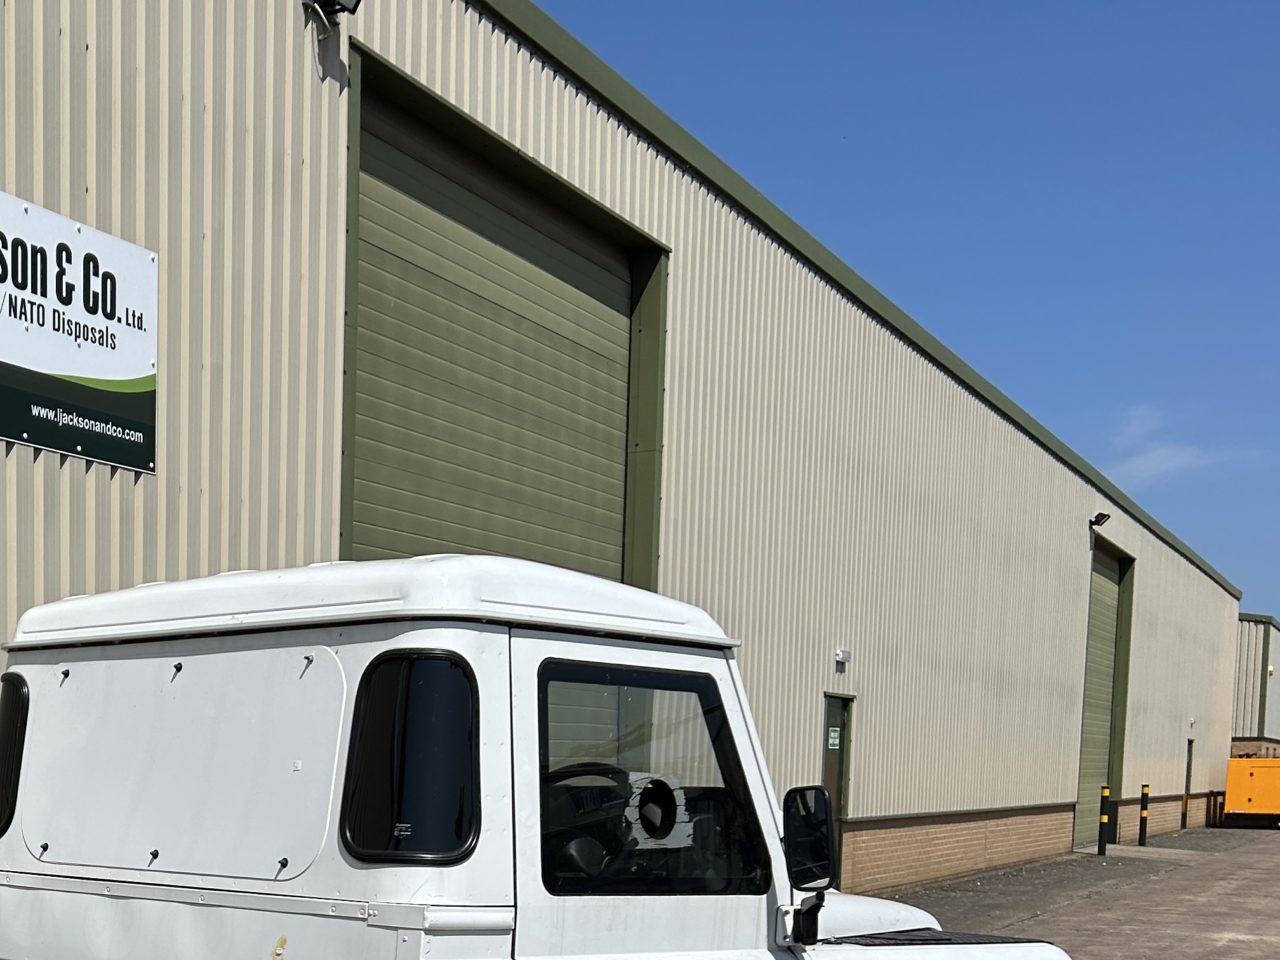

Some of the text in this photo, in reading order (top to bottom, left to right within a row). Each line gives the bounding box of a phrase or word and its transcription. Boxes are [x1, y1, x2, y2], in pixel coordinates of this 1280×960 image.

[55, 242, 76, 307] &
[82, 252, 122, 324] Co.
[125, 307, 147, 332] Ltd.
[52, 308, 117, 350] Disposals
[31, 404, 144, 443] www.ljacksonandco.com
